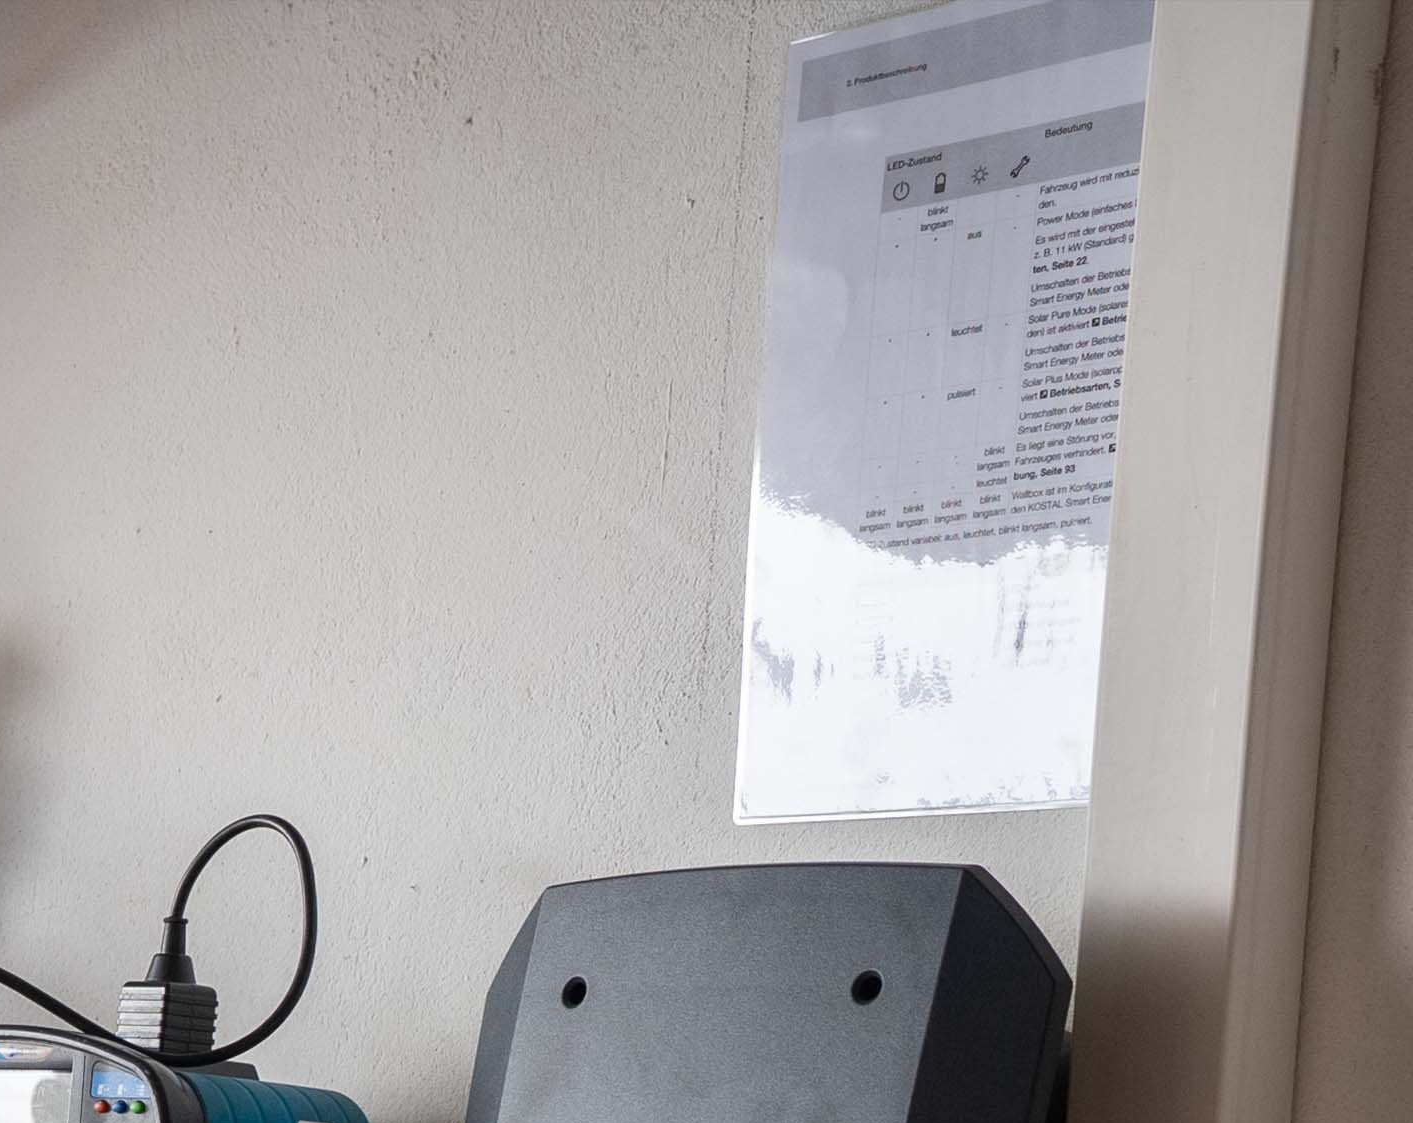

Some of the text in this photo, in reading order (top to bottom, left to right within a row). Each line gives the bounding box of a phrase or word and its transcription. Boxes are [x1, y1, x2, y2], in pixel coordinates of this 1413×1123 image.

[1044, 121, 1093, 138] Bedeutung
[886, 151, 943, 171] LED-Zustand
[1039, 181, 1078, 195] Fahrzeug
[1080, 175, 1098, 187] wird
[1099, 172, 1113, 183] mit
[927, 206, 949, 216] blinkt
[1038, 199, 1055, 209] den.
[1036, 215, 1063, 226] Power
[1065, 209, 1090, 222] Mode
[920, 220, 954, 232] langsam
[1035, 235, 1046, 245] Es
[1048, 231, 1066, 242] wird
[1067, 229, 1081, 239] mit
[1082, 226, 1096, 236] der
[1056, 245, 1065, 254] 11
[1068, 242, 1083, 252] kW
[1052, 260, 1074, 271] Seite
[1031, 276, 1080, 292] Umschalten
[1081, 273, 1096, 284] der
[1029, 295, 1055, 307] Smart
[1056, 290, 1085, 303] Energy
[1087, 285, 1111, 297] Meter
[1028, 304, 1097, 325] Solar Pure Mode
[951, 324, 983, 336] leuchtet
[1046, 325, 1056, 335] ist
[1024, 341, 1074, 357] Umschalten
[1075, 338, 1089, 349] der
[1023, 359, 1049, 371] Smart
[1050, 355, 1079, 368] Energy
[1080, 350, 1105, 362] Meter
[1021, 369, 1089, 388] Solar Plus Mode
[1049, 382, 1111, 398] Betriebsarten,
[1019, 406, 1068, 421] Umschalten
[1069, 404, 1083, 415] der
[1017, 415, 1099, 435] Smart Energy Meter
[983, 446, 1005, 457] blinkt
[1016, 442, 1027, 452] Es
[976, 460, 1011, 471] langsam
[1040, 467, 1063, 477] Seite
[976, 476, 1008, 488] leuchtet
[940, 499, 962, 510] blinkt
[979, 494, 1001, 505] blinkt
[1010, 506, 1026, 514] den
[1027, 499, 1063, 512] KOSTAL
[1065, 497, 1090, 507] Smart
[903, 504, 925, 514] blinkt
